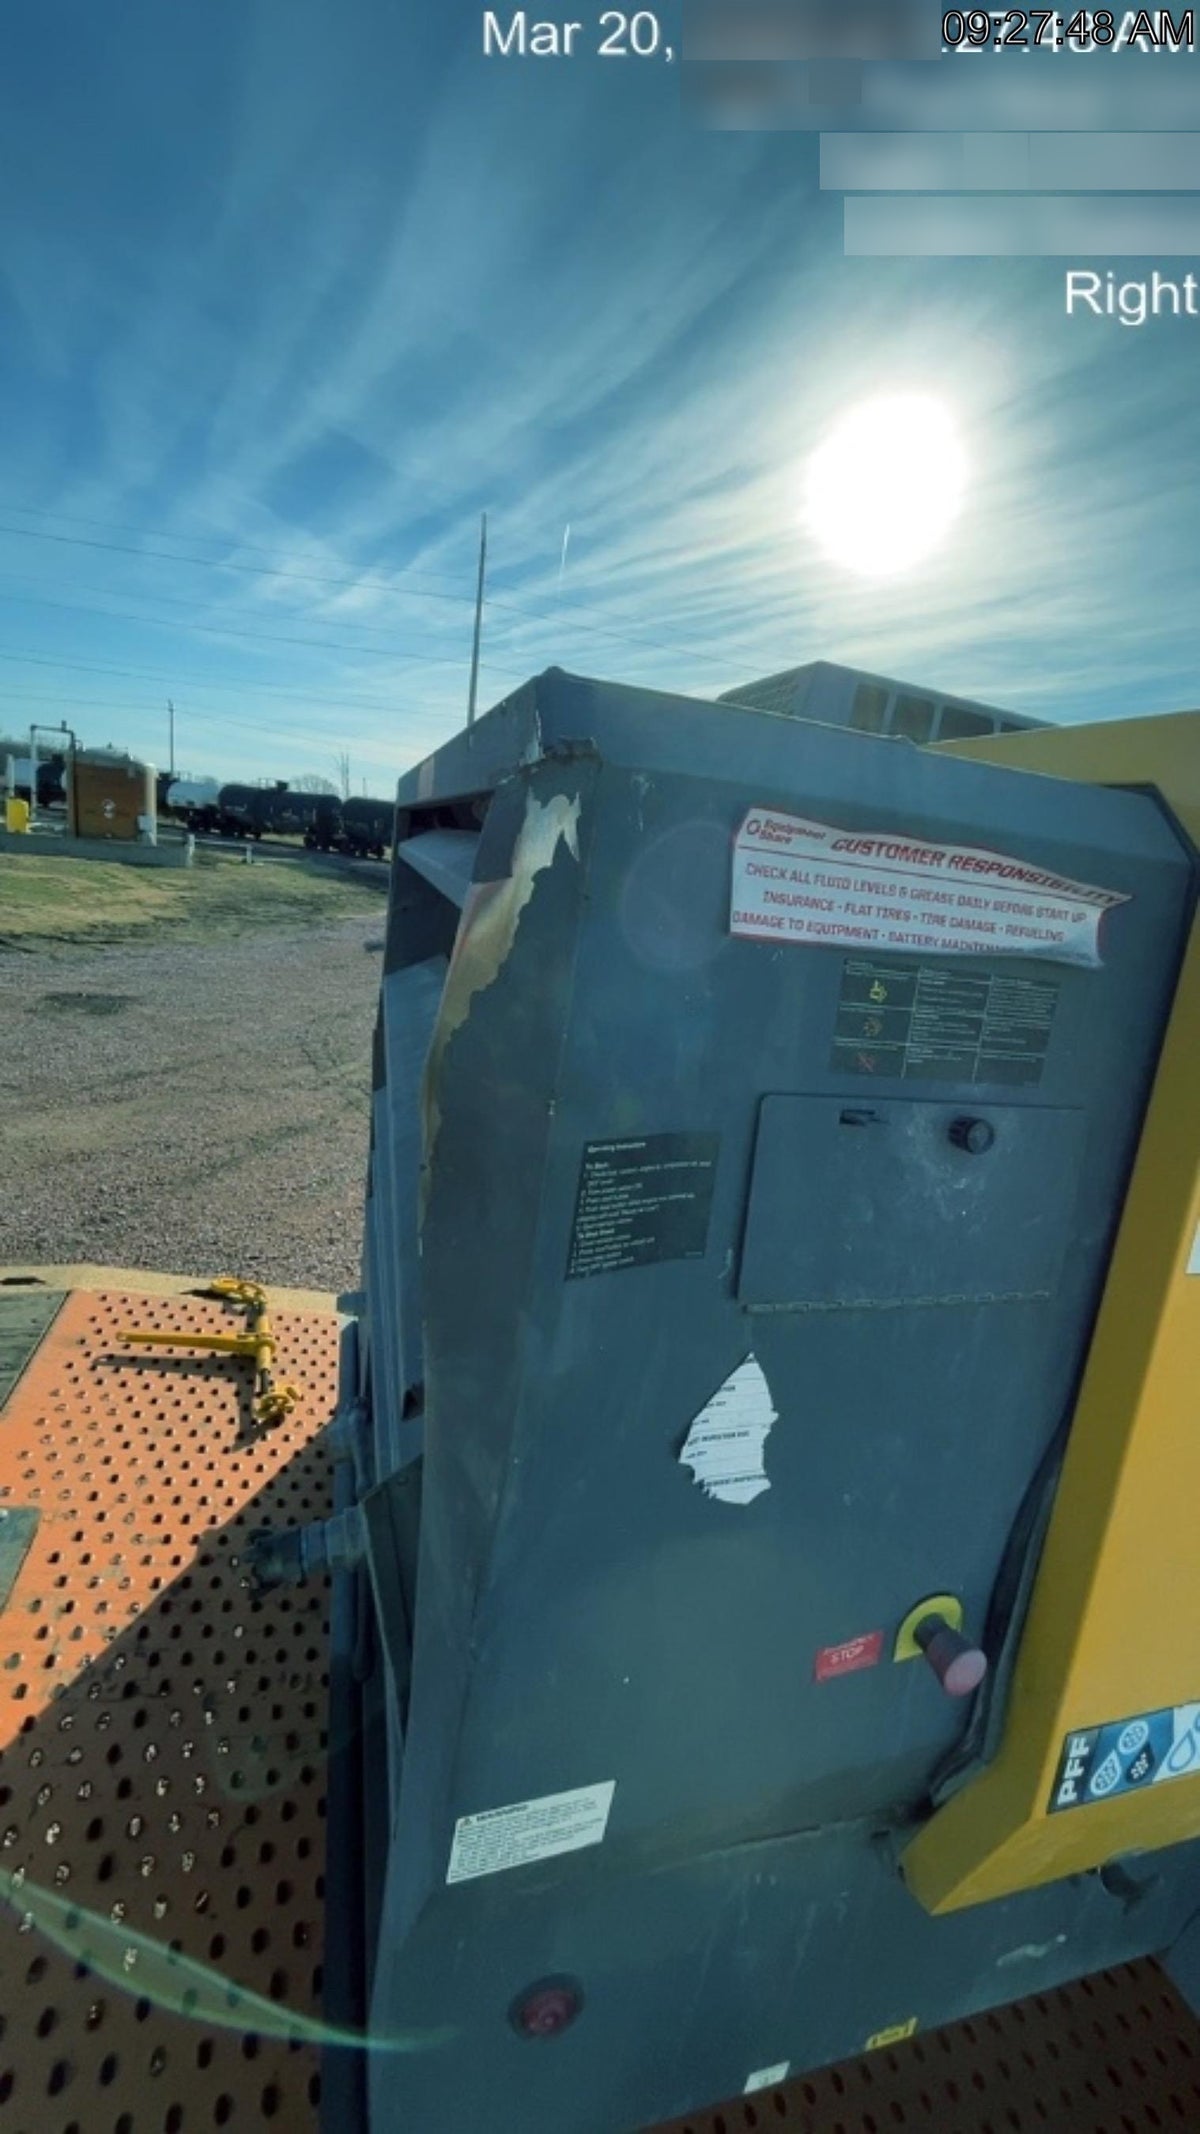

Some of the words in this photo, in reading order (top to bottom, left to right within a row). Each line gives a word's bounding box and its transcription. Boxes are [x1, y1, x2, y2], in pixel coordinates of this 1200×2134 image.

[831, 839, 946, 866] CUSTOMER
[745, 862, 787, 880] CHECK
[789, 869, 811, 885] ALL
[813, 873, 850, 890] FLUID
[853, 879, 898, 898] LEVELS
[910, 887, 954, 906] GREASE
[957, 894, 990, 911] DAILY
[993, 900, 1035, 917] BEFORE
[1036, 907, 1070, 922] START
[1071, 912, 1087, 923] UP
[732, 910, 786, 930] DAMAGE
[788, 917, 805, 930] TO
[806, 919, 879, 940] EQUIPMENT
[888, 931, 938, 947] BATTERY
[763, 891, 835, 912] INSURANCE
[844, 902, 873, 917] FLAT
[876, 905, 911, 923] TIRES
[921, 912, 948, 928] TIRE
[950, 917, 997, 935] DAMAGE
[831, 1645, 864, 1665] STOP
[1057, 1737, 1090, 1805] PFF
